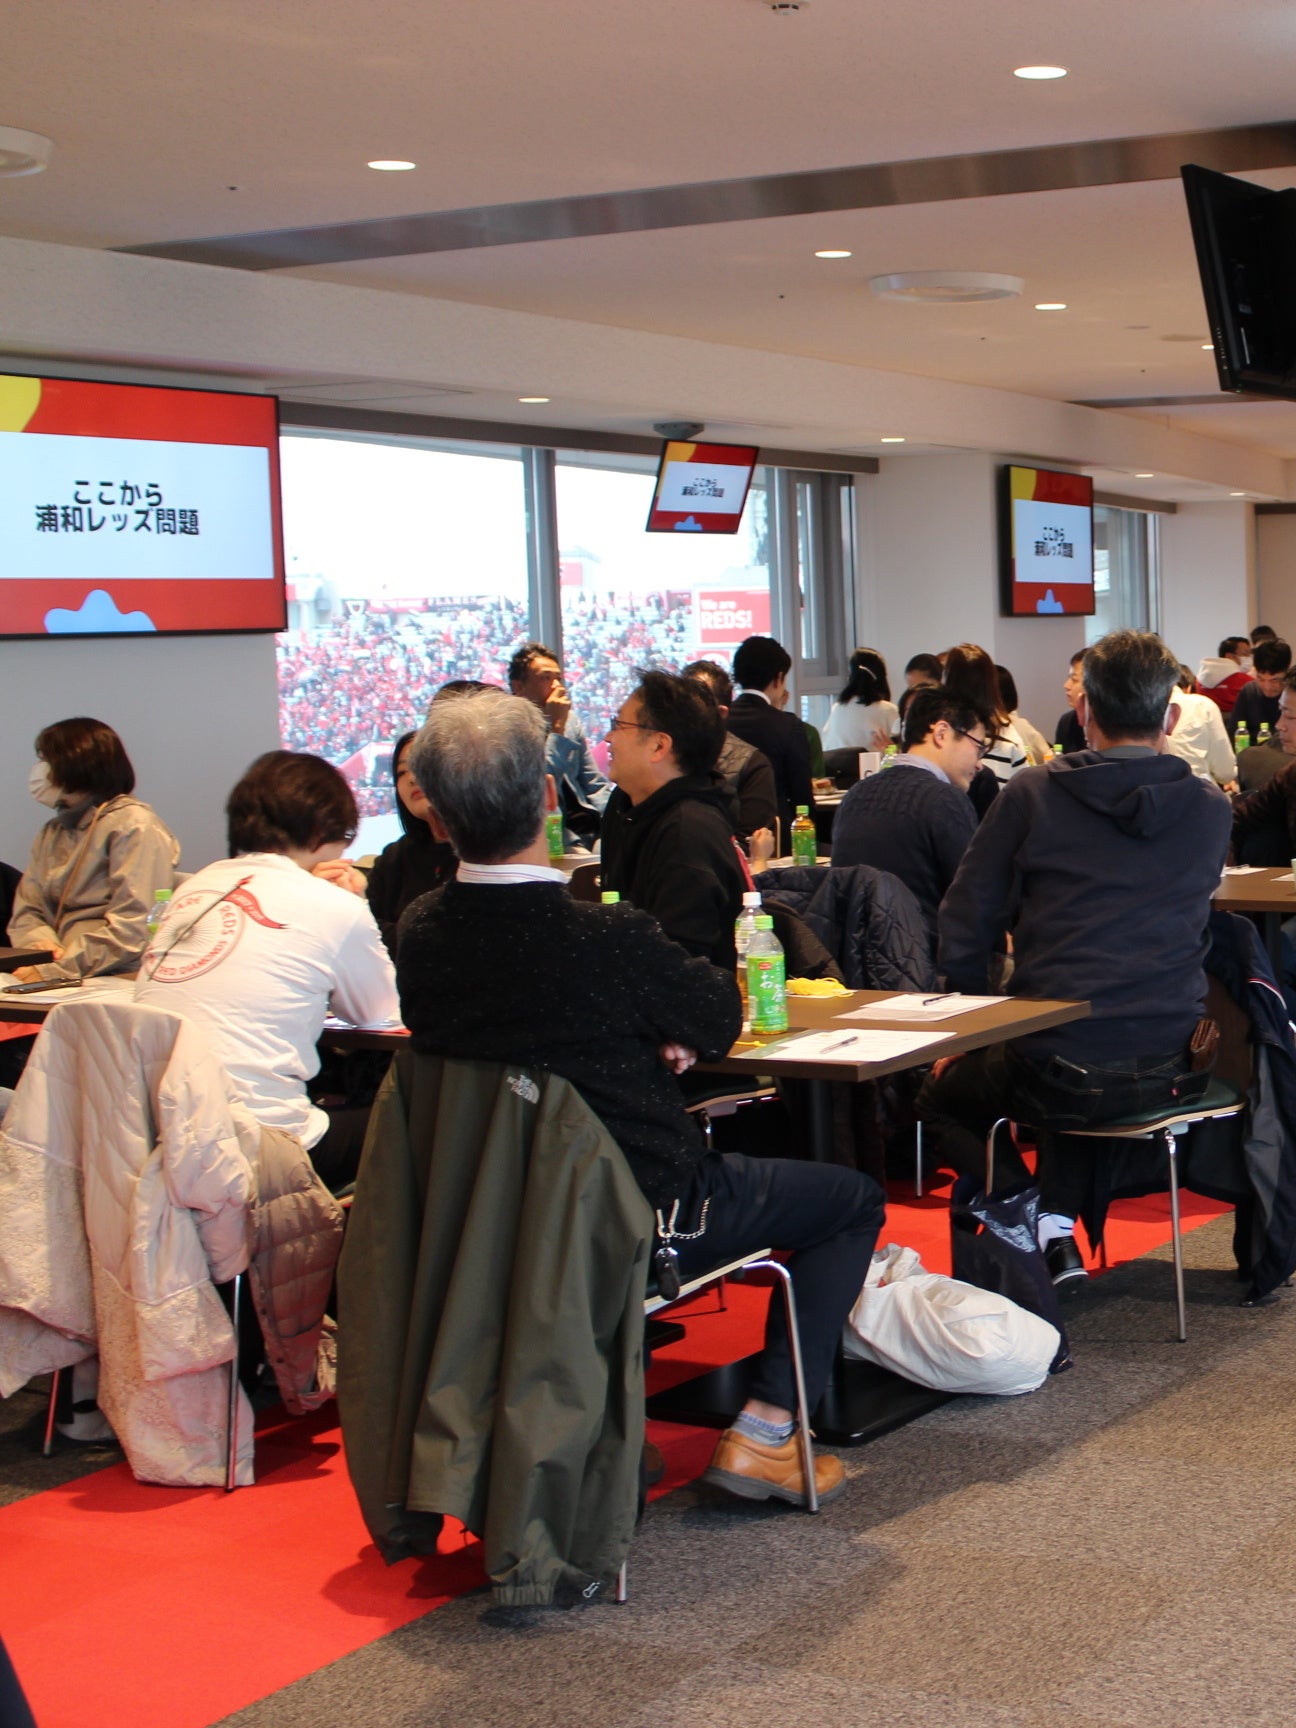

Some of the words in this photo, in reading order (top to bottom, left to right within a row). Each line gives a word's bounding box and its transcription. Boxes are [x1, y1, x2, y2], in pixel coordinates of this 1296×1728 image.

[73, 480, 162, 507] ここから
[35, 504, 200, 536] 浦和レッズ問題
[701, 610, 752, 629] REDS!
[217, 904, 237, 935] REDS
